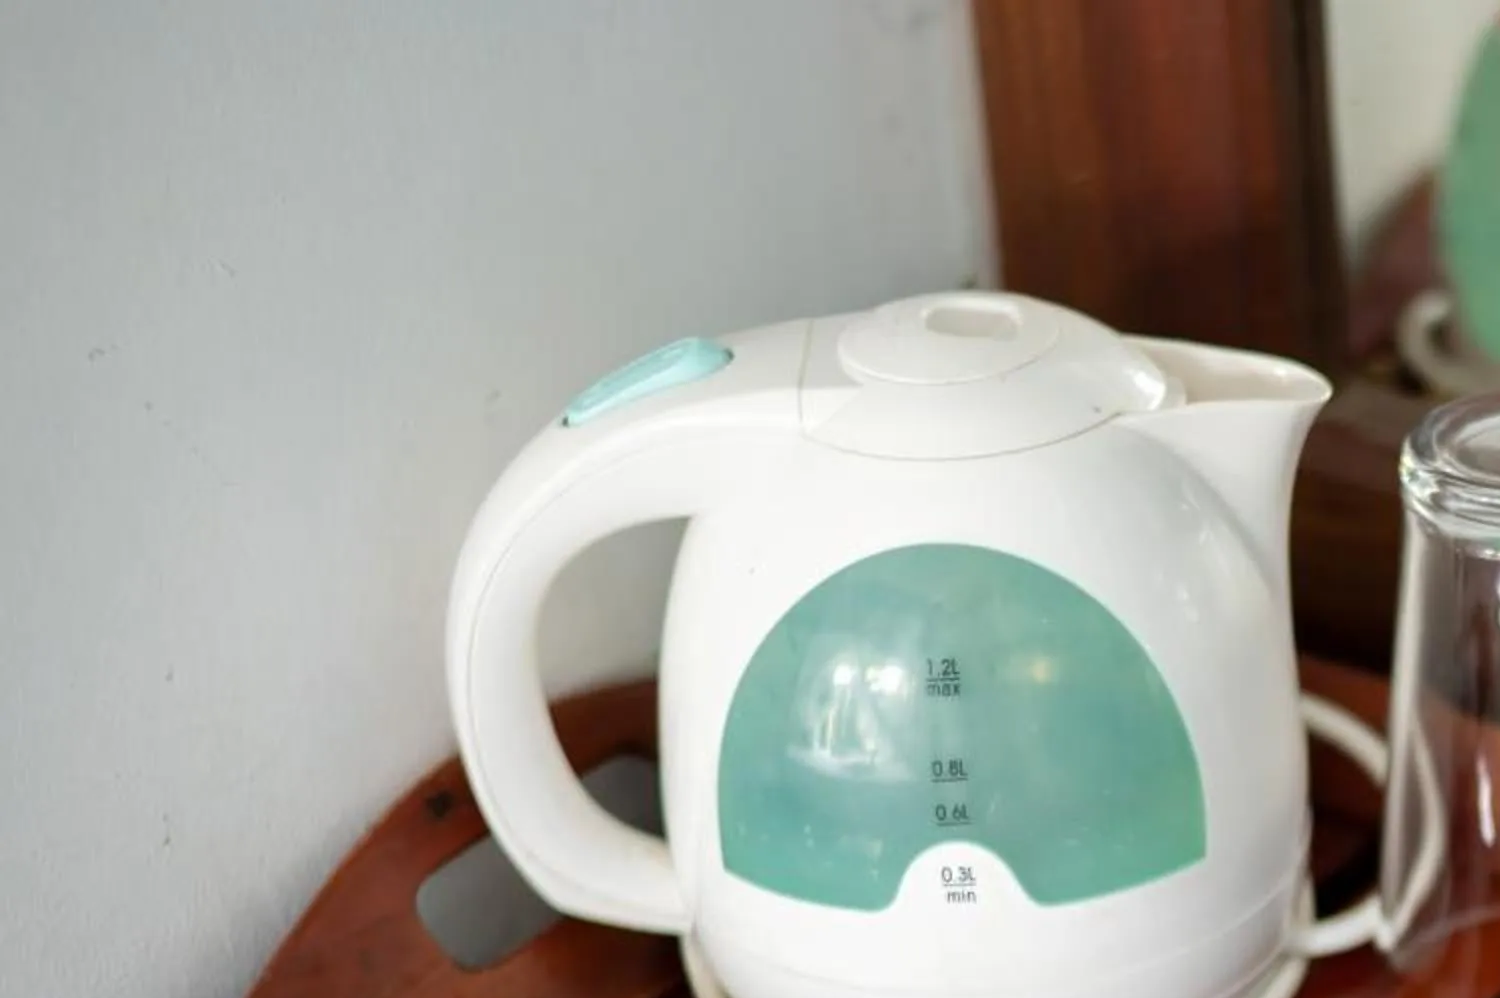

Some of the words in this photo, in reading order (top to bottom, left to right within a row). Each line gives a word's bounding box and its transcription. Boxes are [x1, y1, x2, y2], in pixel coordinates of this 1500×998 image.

[926, 657, 960, 677] 1.2L
[926, 683, 961, 698] max
[941, 866, 977, 884] 0.3L
[947, 889, 977, 904] min
